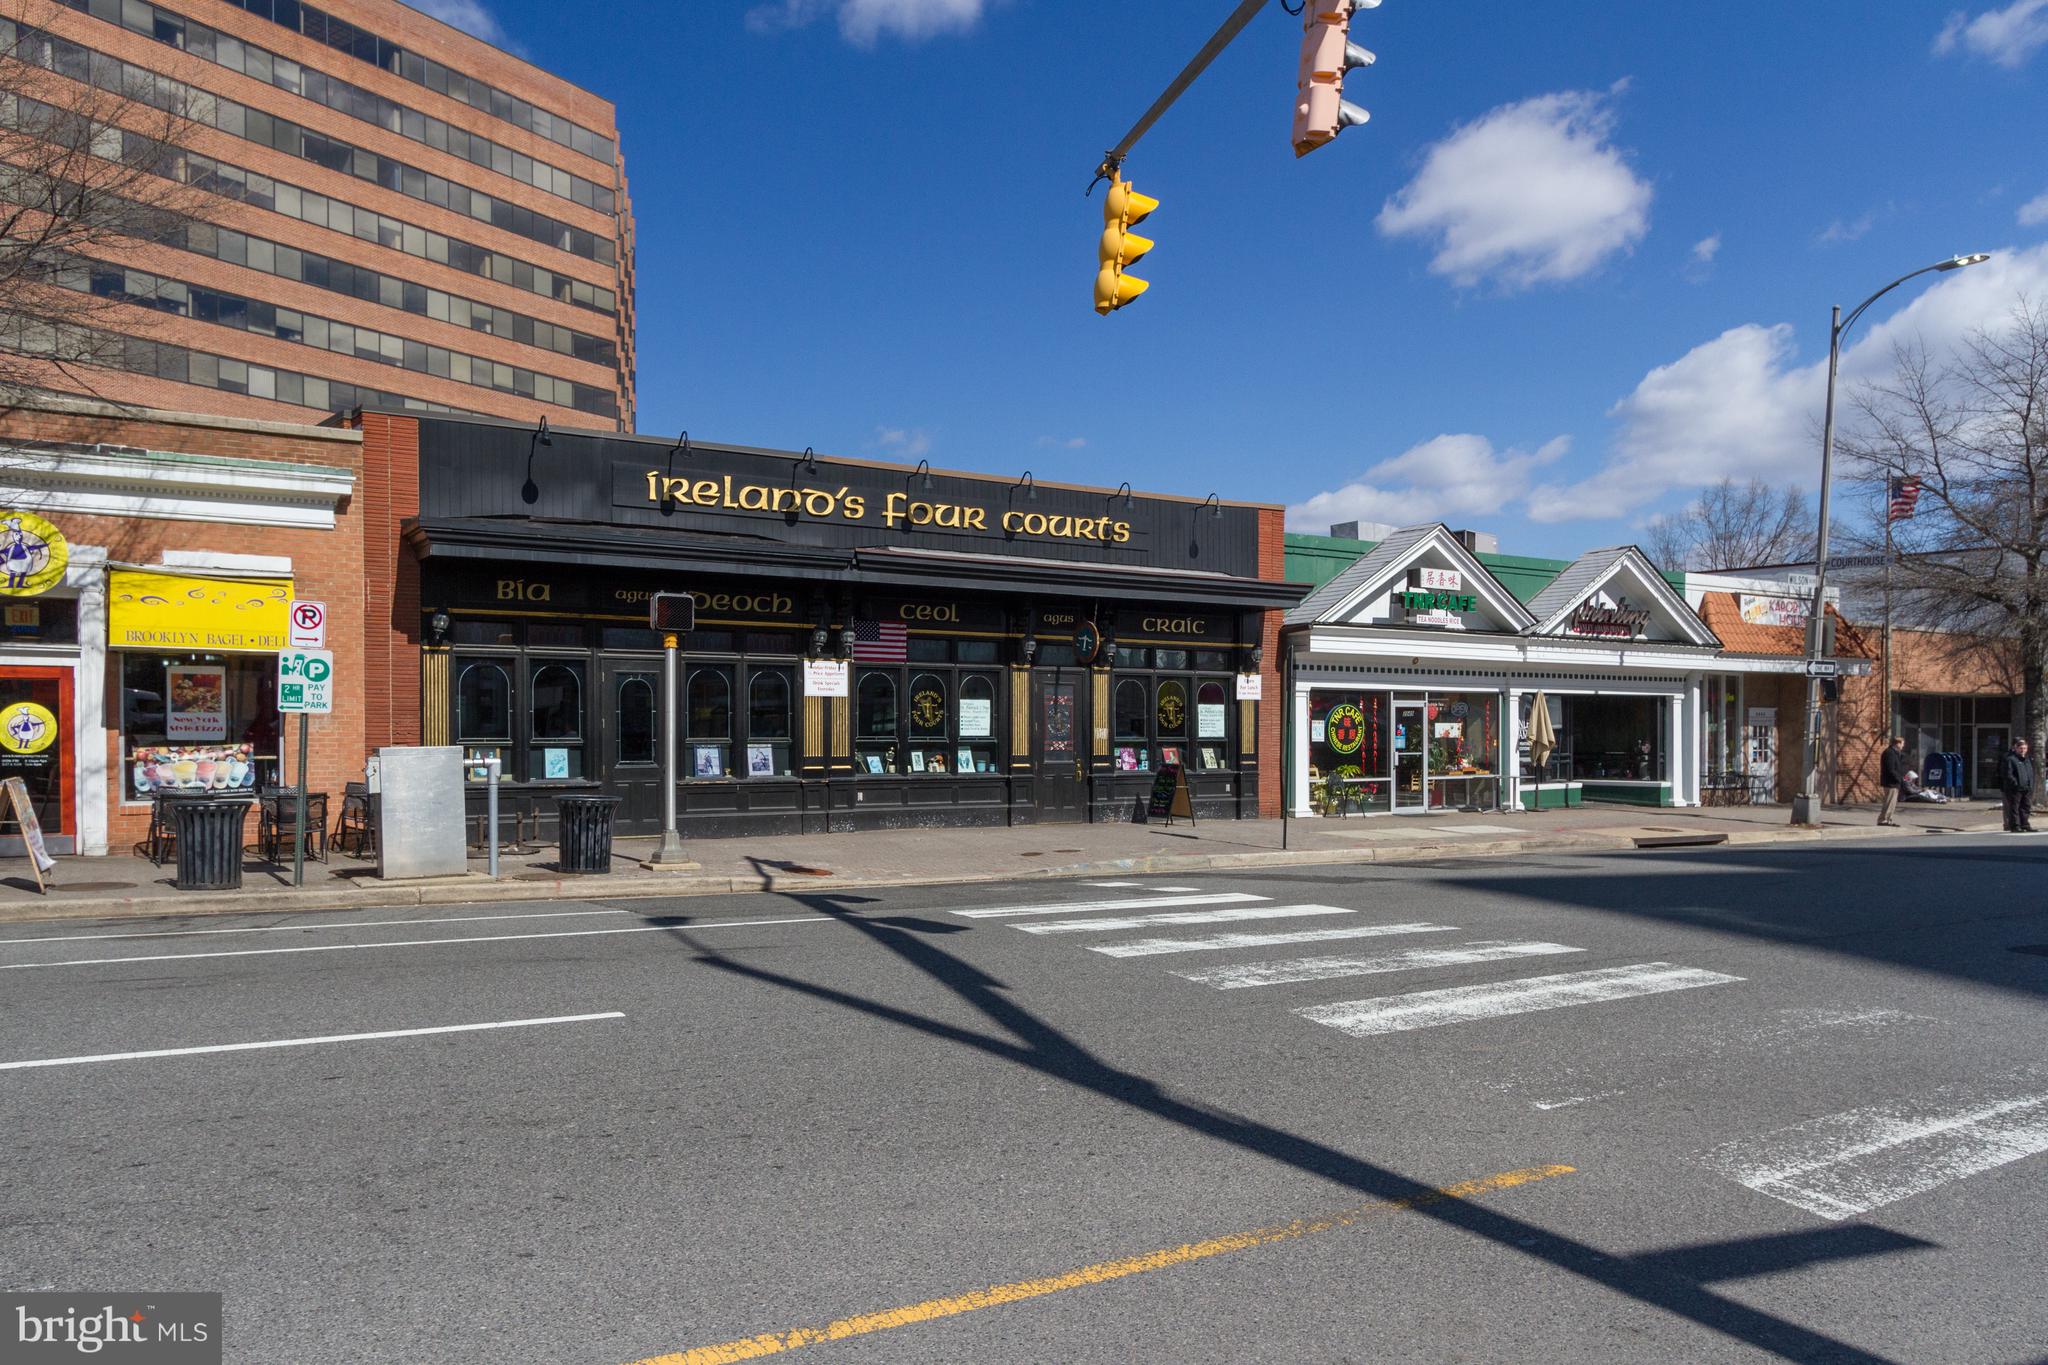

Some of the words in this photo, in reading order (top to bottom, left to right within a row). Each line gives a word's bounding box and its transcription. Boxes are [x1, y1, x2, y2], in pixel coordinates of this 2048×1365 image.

[1831, 555, 1886, 568] COURTHOUSE
[615, 589, 652, 602] agu
[1403, 591, 1436, 610] TNR
[1437, 591, 1478, 612] CAFE
[1043, 612, 1075, 625] agus
[1428, 616, 1449, 624] NOODLES
[125, 630, 199, 644] BROOKLYN
[206, 632, 248, 646] BAGEL
[284, 684, 291, 694] 2
[307, 684, 326, 692] PAY
[311, 693, 323, 701] TO
[303, 701, 328, 709] PARK
[1331, 708, 1346, 725] TNR
[1345, 706, 1362, 725] CAFE
[169, 725, 194, 733] Style
